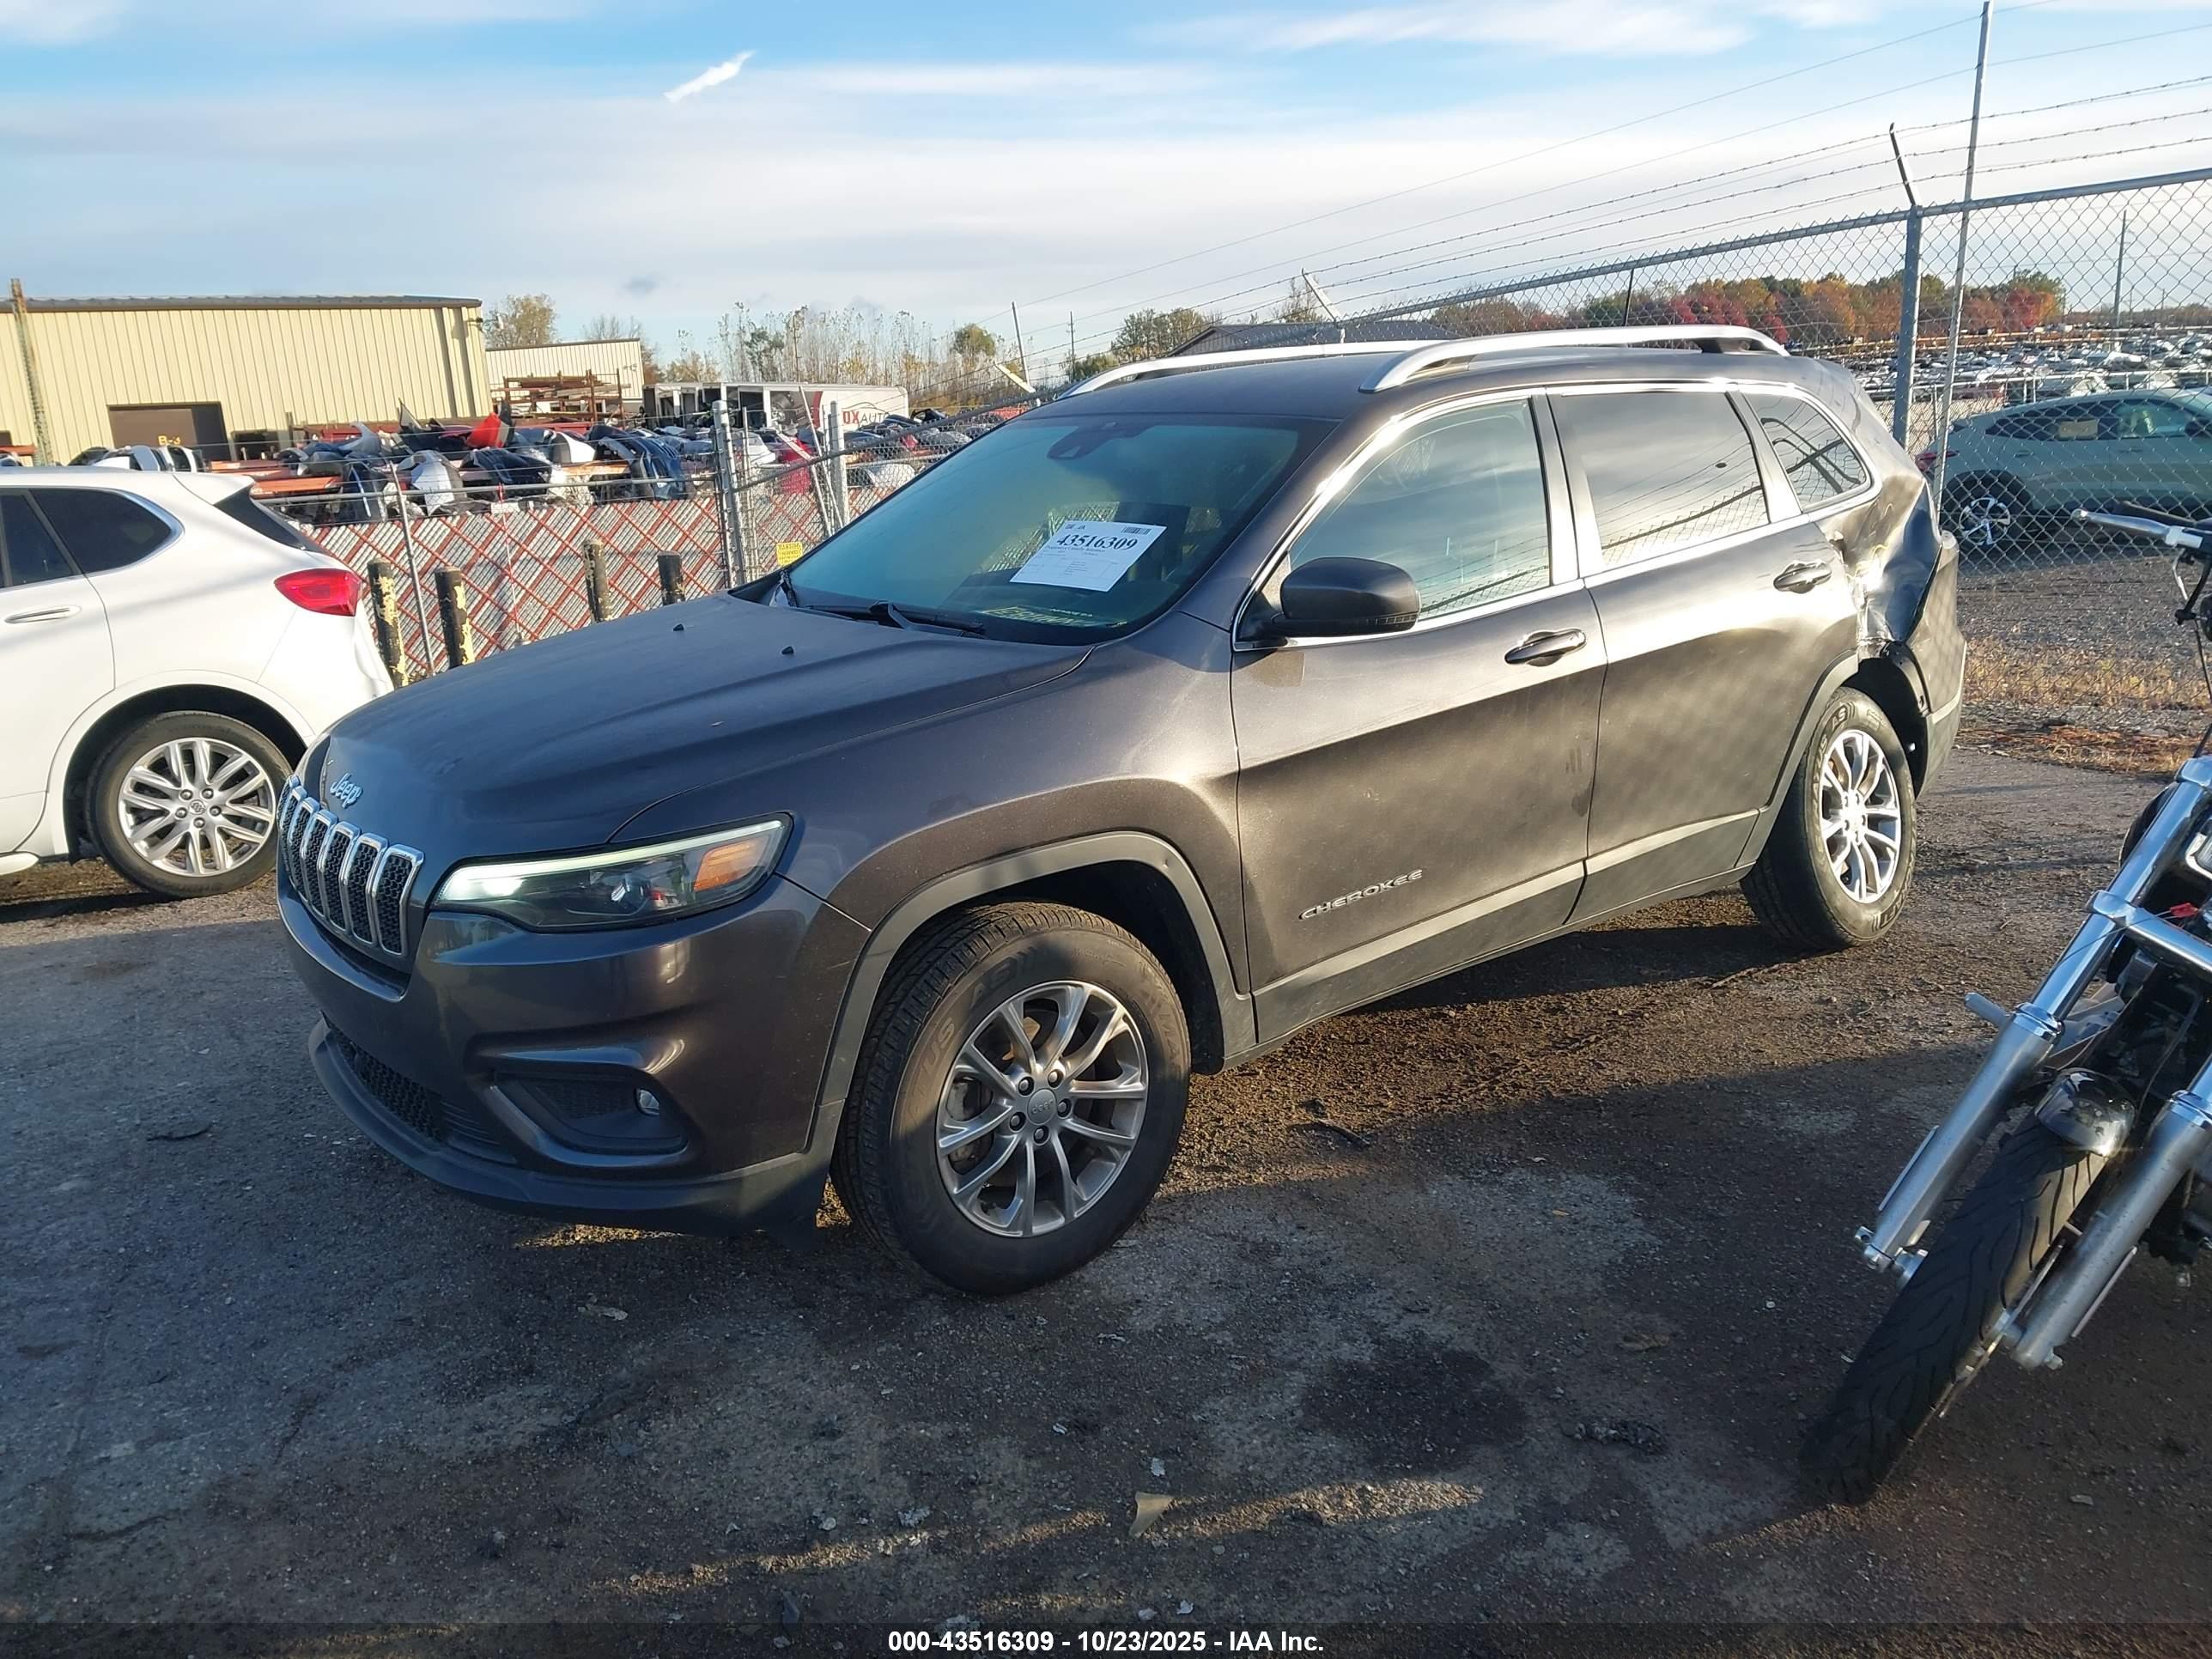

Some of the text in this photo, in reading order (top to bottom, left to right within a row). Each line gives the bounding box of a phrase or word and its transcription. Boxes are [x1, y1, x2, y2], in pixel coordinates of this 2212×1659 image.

[1057, 534, 1138, 550] 43516309
[330, 773, 362, 808] Jeep
[1297, 868, 1423, 921] CHEROKEE
